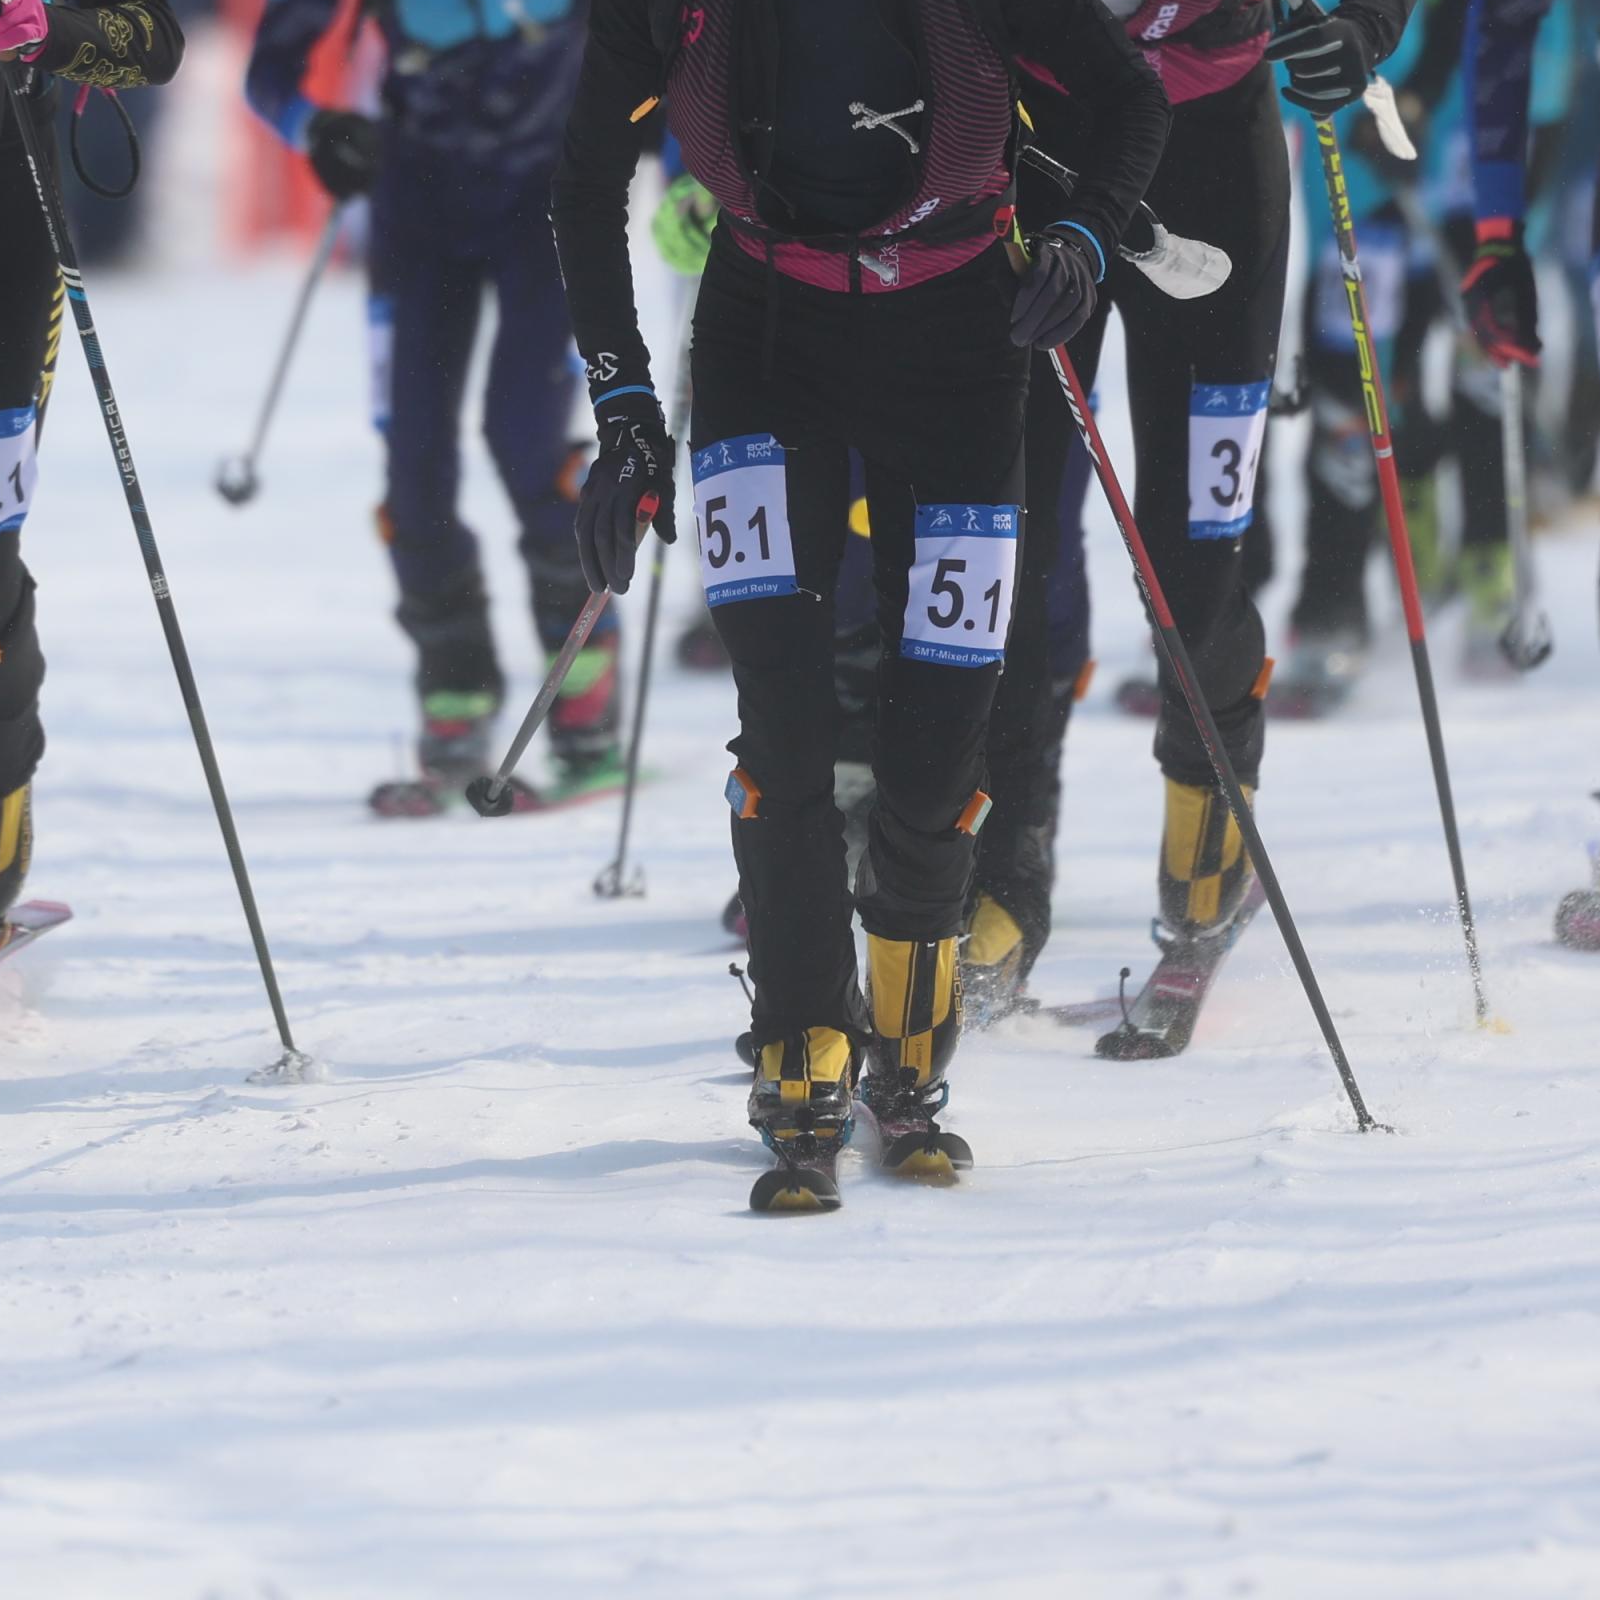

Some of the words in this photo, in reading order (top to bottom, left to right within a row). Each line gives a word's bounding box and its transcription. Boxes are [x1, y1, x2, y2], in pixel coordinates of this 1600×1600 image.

[103, 388, 136, 487] VERTICAL
[705, 495, 771, 569] 5.1
[708, 585, 748, 602] SMT-Mixed
[750, 582, 779, 593] Relay
[927, 558, 1002, 633] 5.1
[913, 646, 969, 663] SMT-Mixed
[970, 654, 996, 665] Relay
